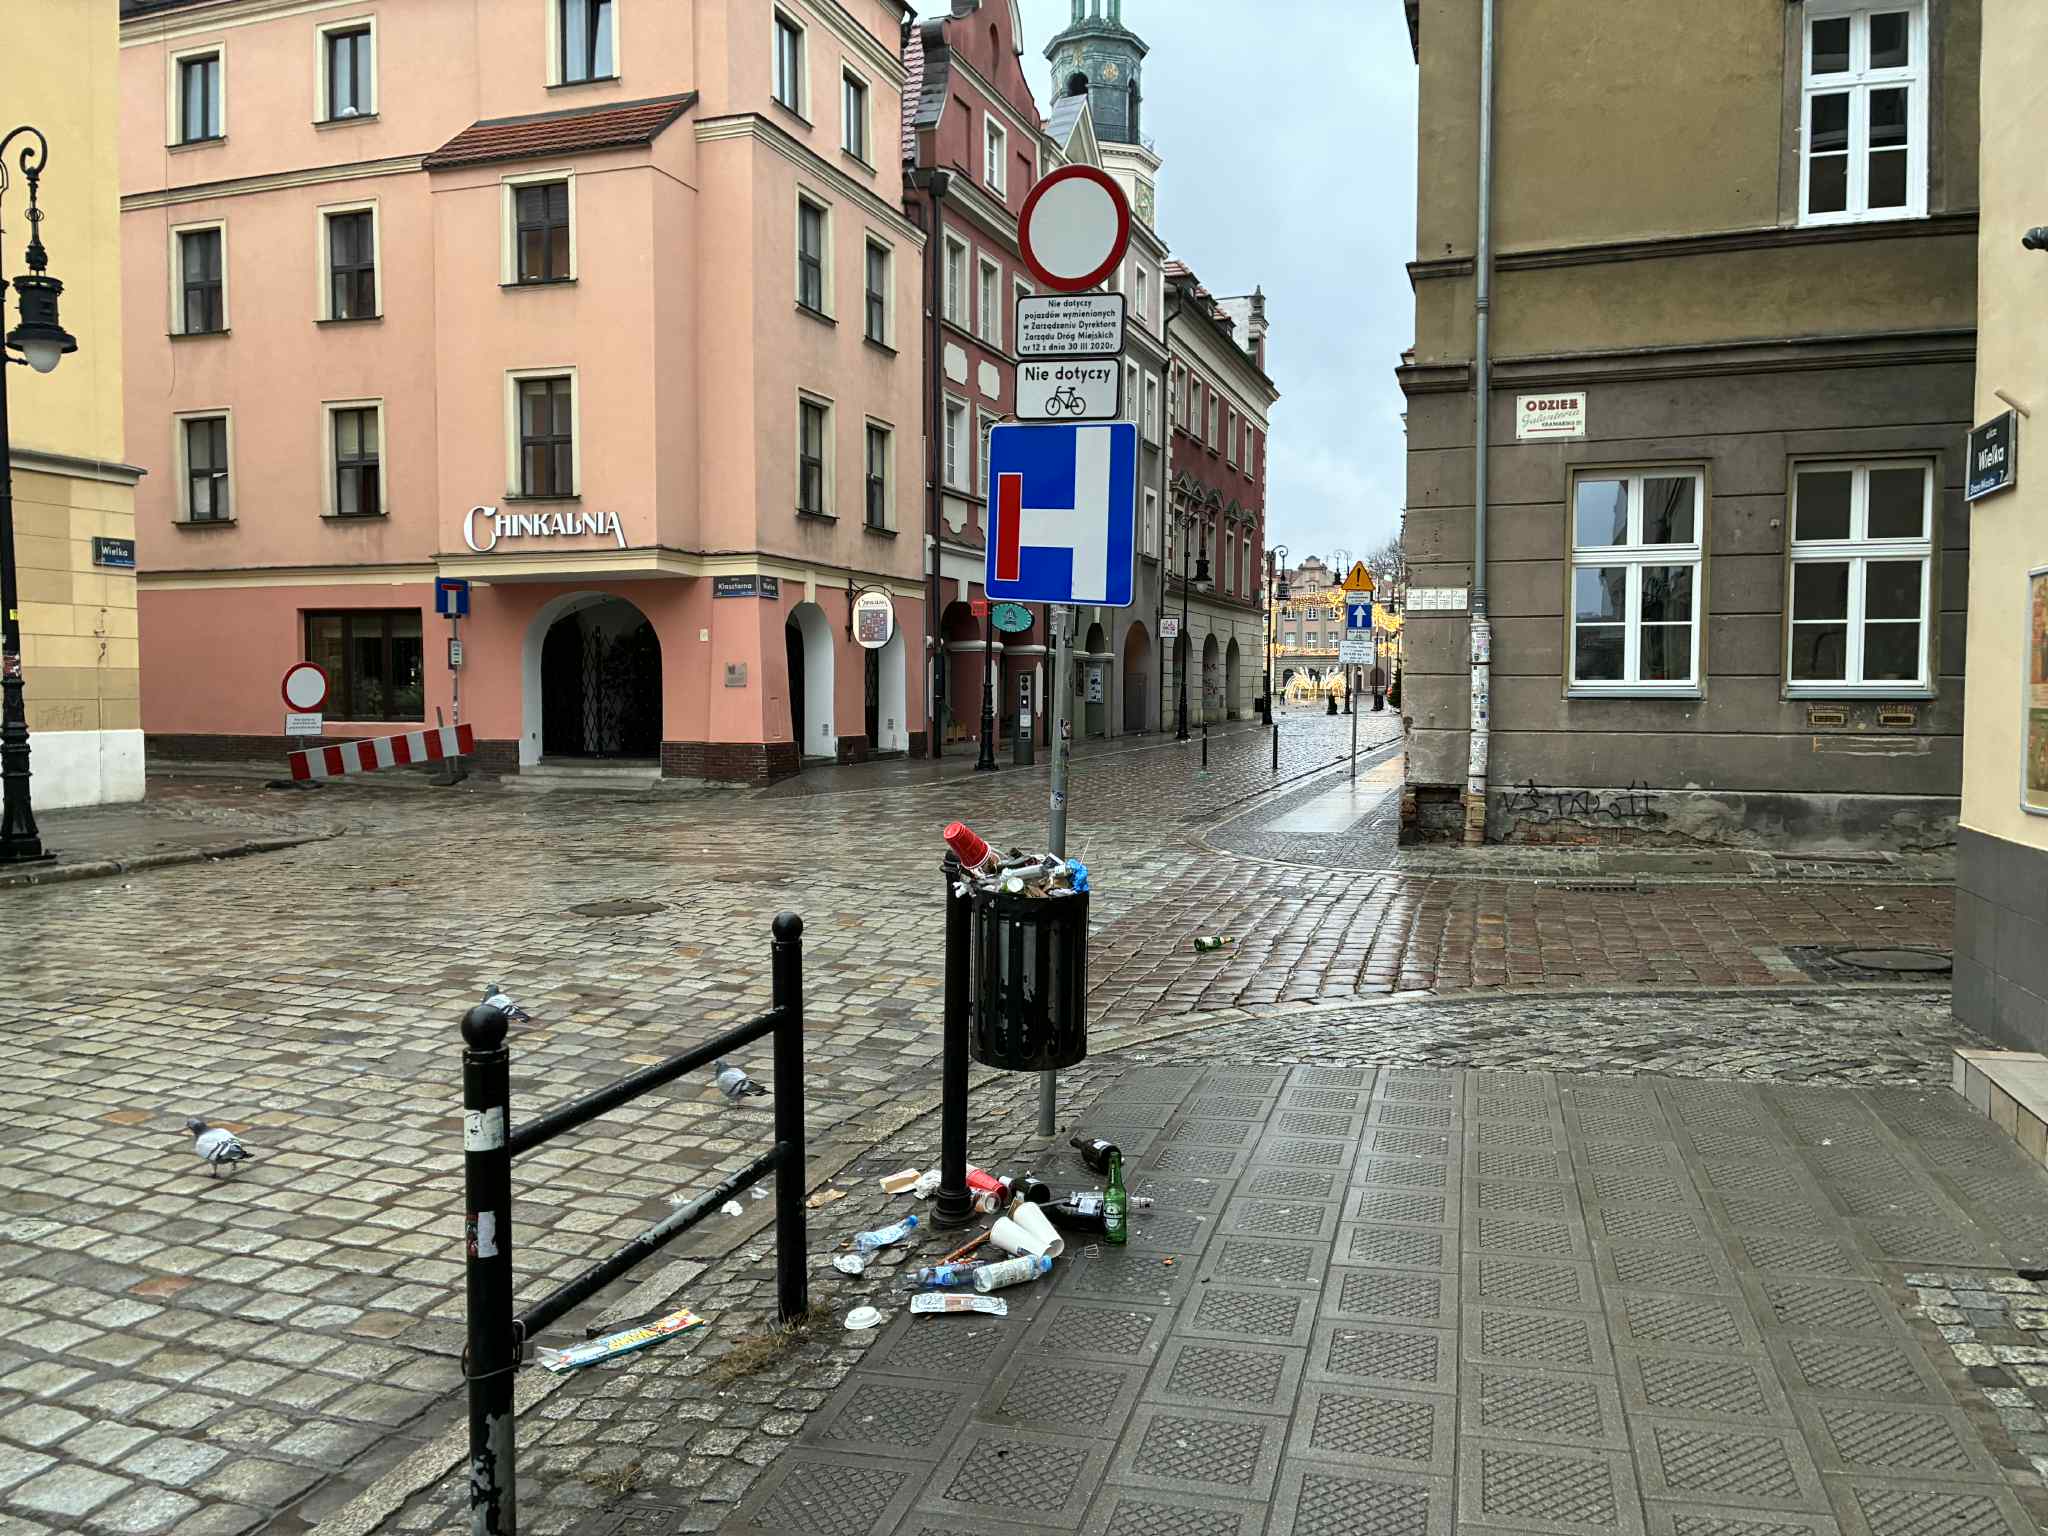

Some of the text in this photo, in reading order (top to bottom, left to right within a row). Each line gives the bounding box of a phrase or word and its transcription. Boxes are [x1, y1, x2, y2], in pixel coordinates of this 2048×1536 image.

[1063, 299, 1092, 308] dotyczy
[1024, 310, 1116, 320] pojazdów wymienionych
[1078, 321, 1116, 330] Dyrektora
[1078, 331, 1114, 340] Miejskich
[1032, 343, 1040, 351] 12
[1048, 343, 1065, 351] dnia
[1025, 366, 1111, 384] Nie dotyczy
[1978, 443, 2005, 471] Wielka
[101, 545, 128, 557] Wielka
